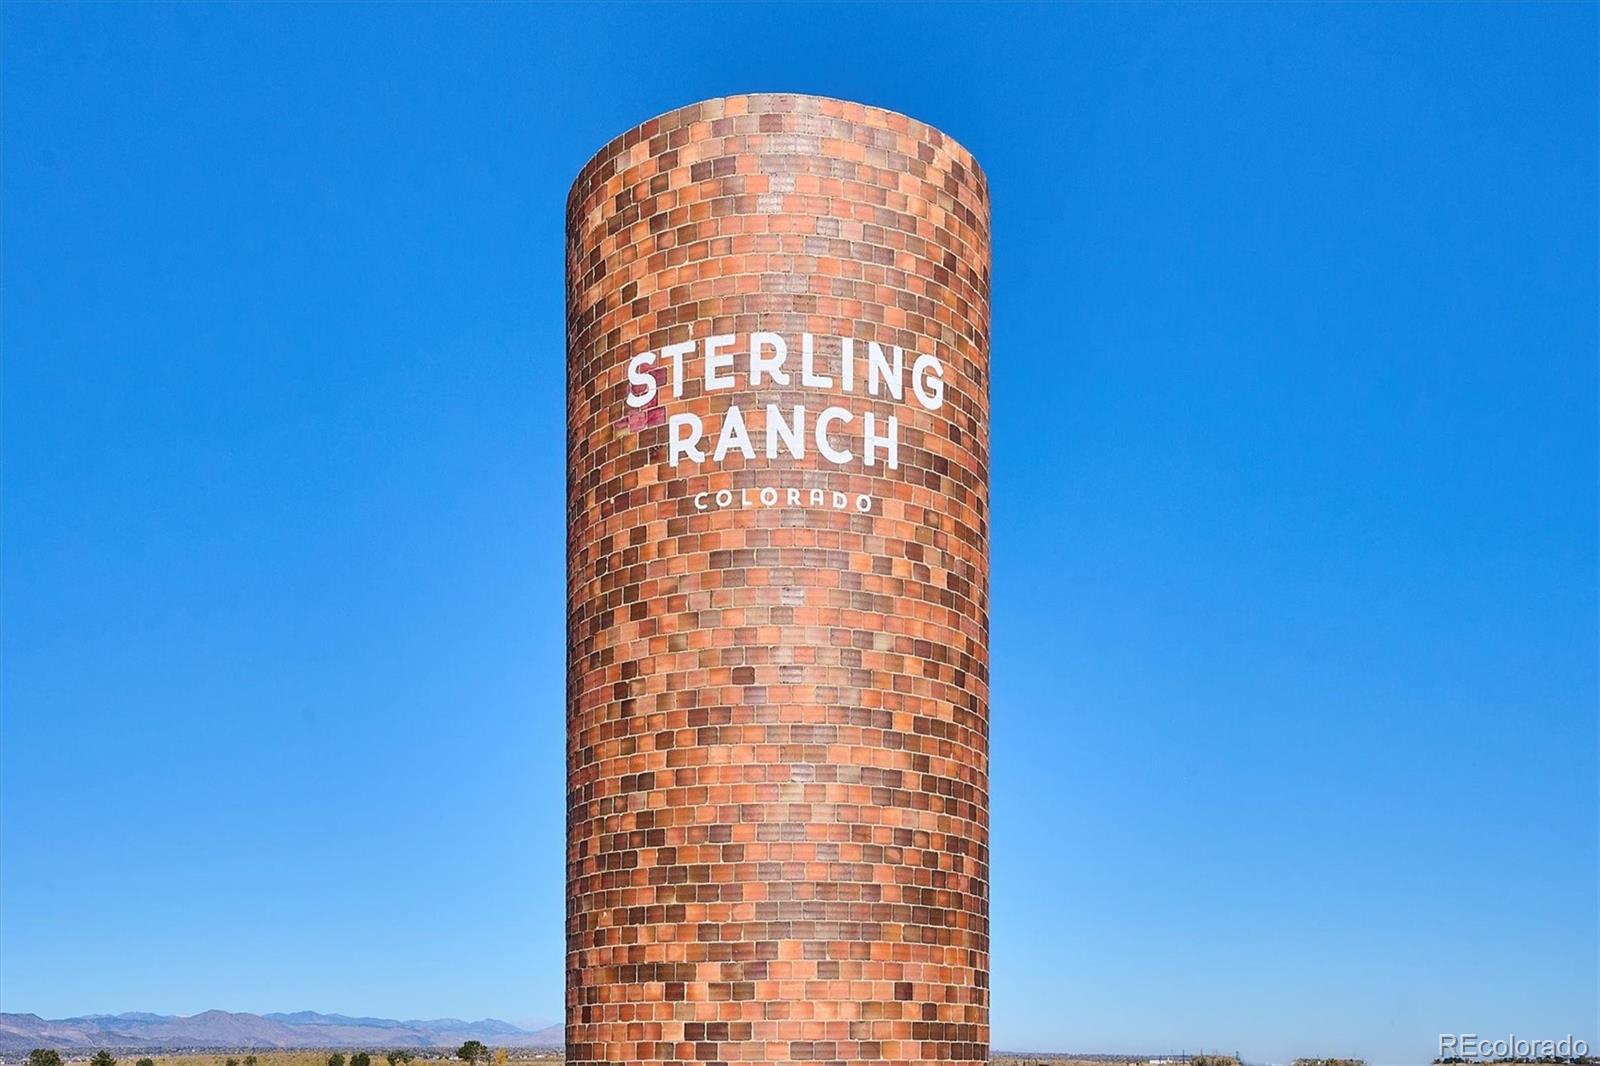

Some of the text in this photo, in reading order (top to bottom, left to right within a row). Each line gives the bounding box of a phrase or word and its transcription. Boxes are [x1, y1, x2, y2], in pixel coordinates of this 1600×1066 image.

[626, 332, 945, 410] STERLING
[668, 404, 899, 470] RANCH
[694, 487, 874, 513] COLORADO
